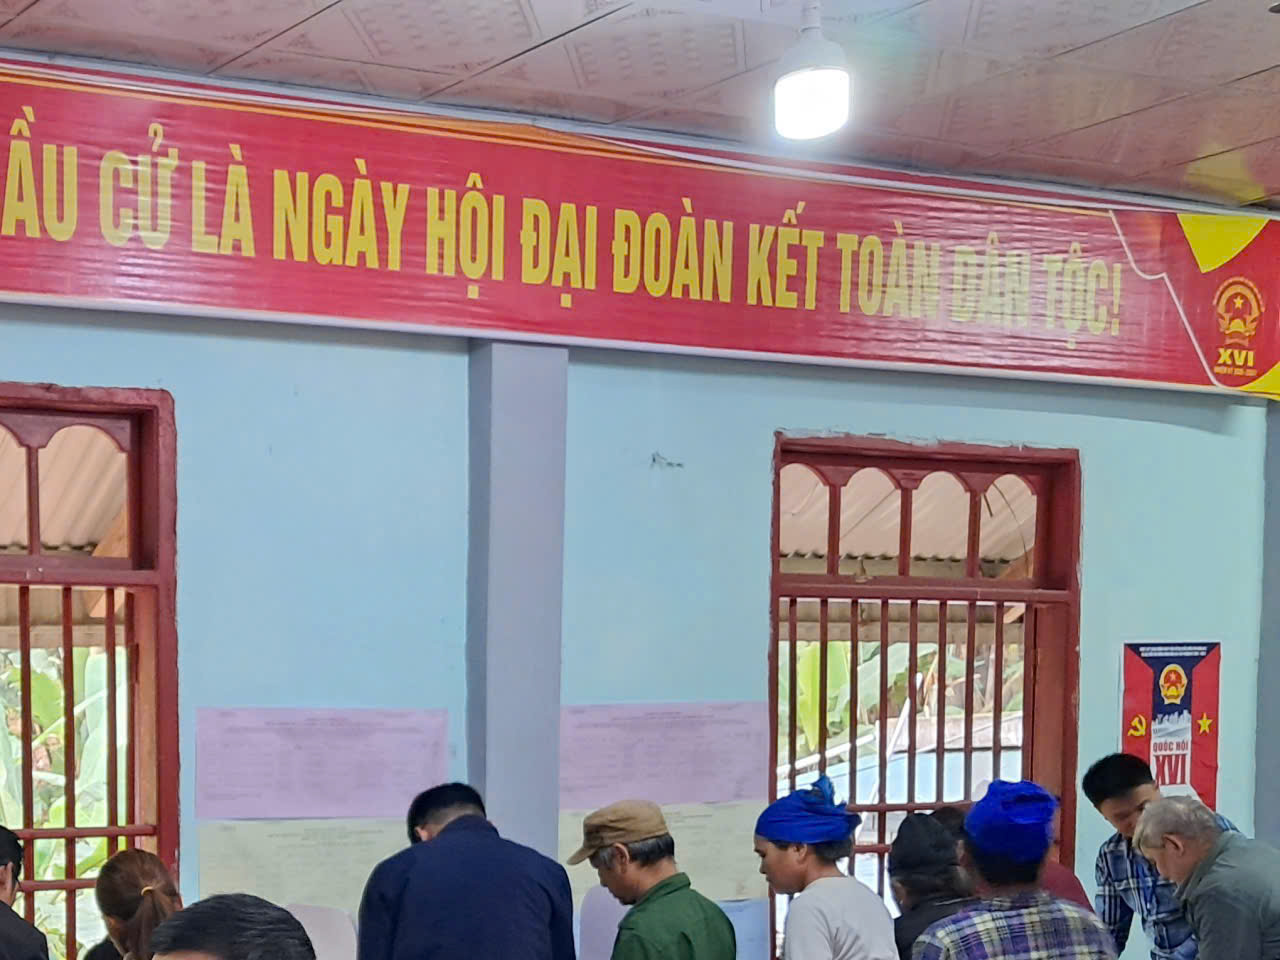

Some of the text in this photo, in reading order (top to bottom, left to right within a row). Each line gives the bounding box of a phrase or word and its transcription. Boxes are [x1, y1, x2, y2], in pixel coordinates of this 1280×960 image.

[99, 122, 179, 249] CỬ
[191, 143, 256, 257] LÀ
[273, 158, 411, 272] NGÀY
[424, 172, 505, 299] HỘI
[520, 197, 598, 308] ĐẠI
[612, 197, 734, 304] ĐOÀN
[746, 201, 825, 311] KẾT
[836, 219, 941, 319] TOÀN
[950, 231, 1031, 329] DÂN
[1043, 241, 1123, 349] TỘC!
[1217, 347, 1254, 368] XVI
[1155, 753, 1187, 786] XVI
